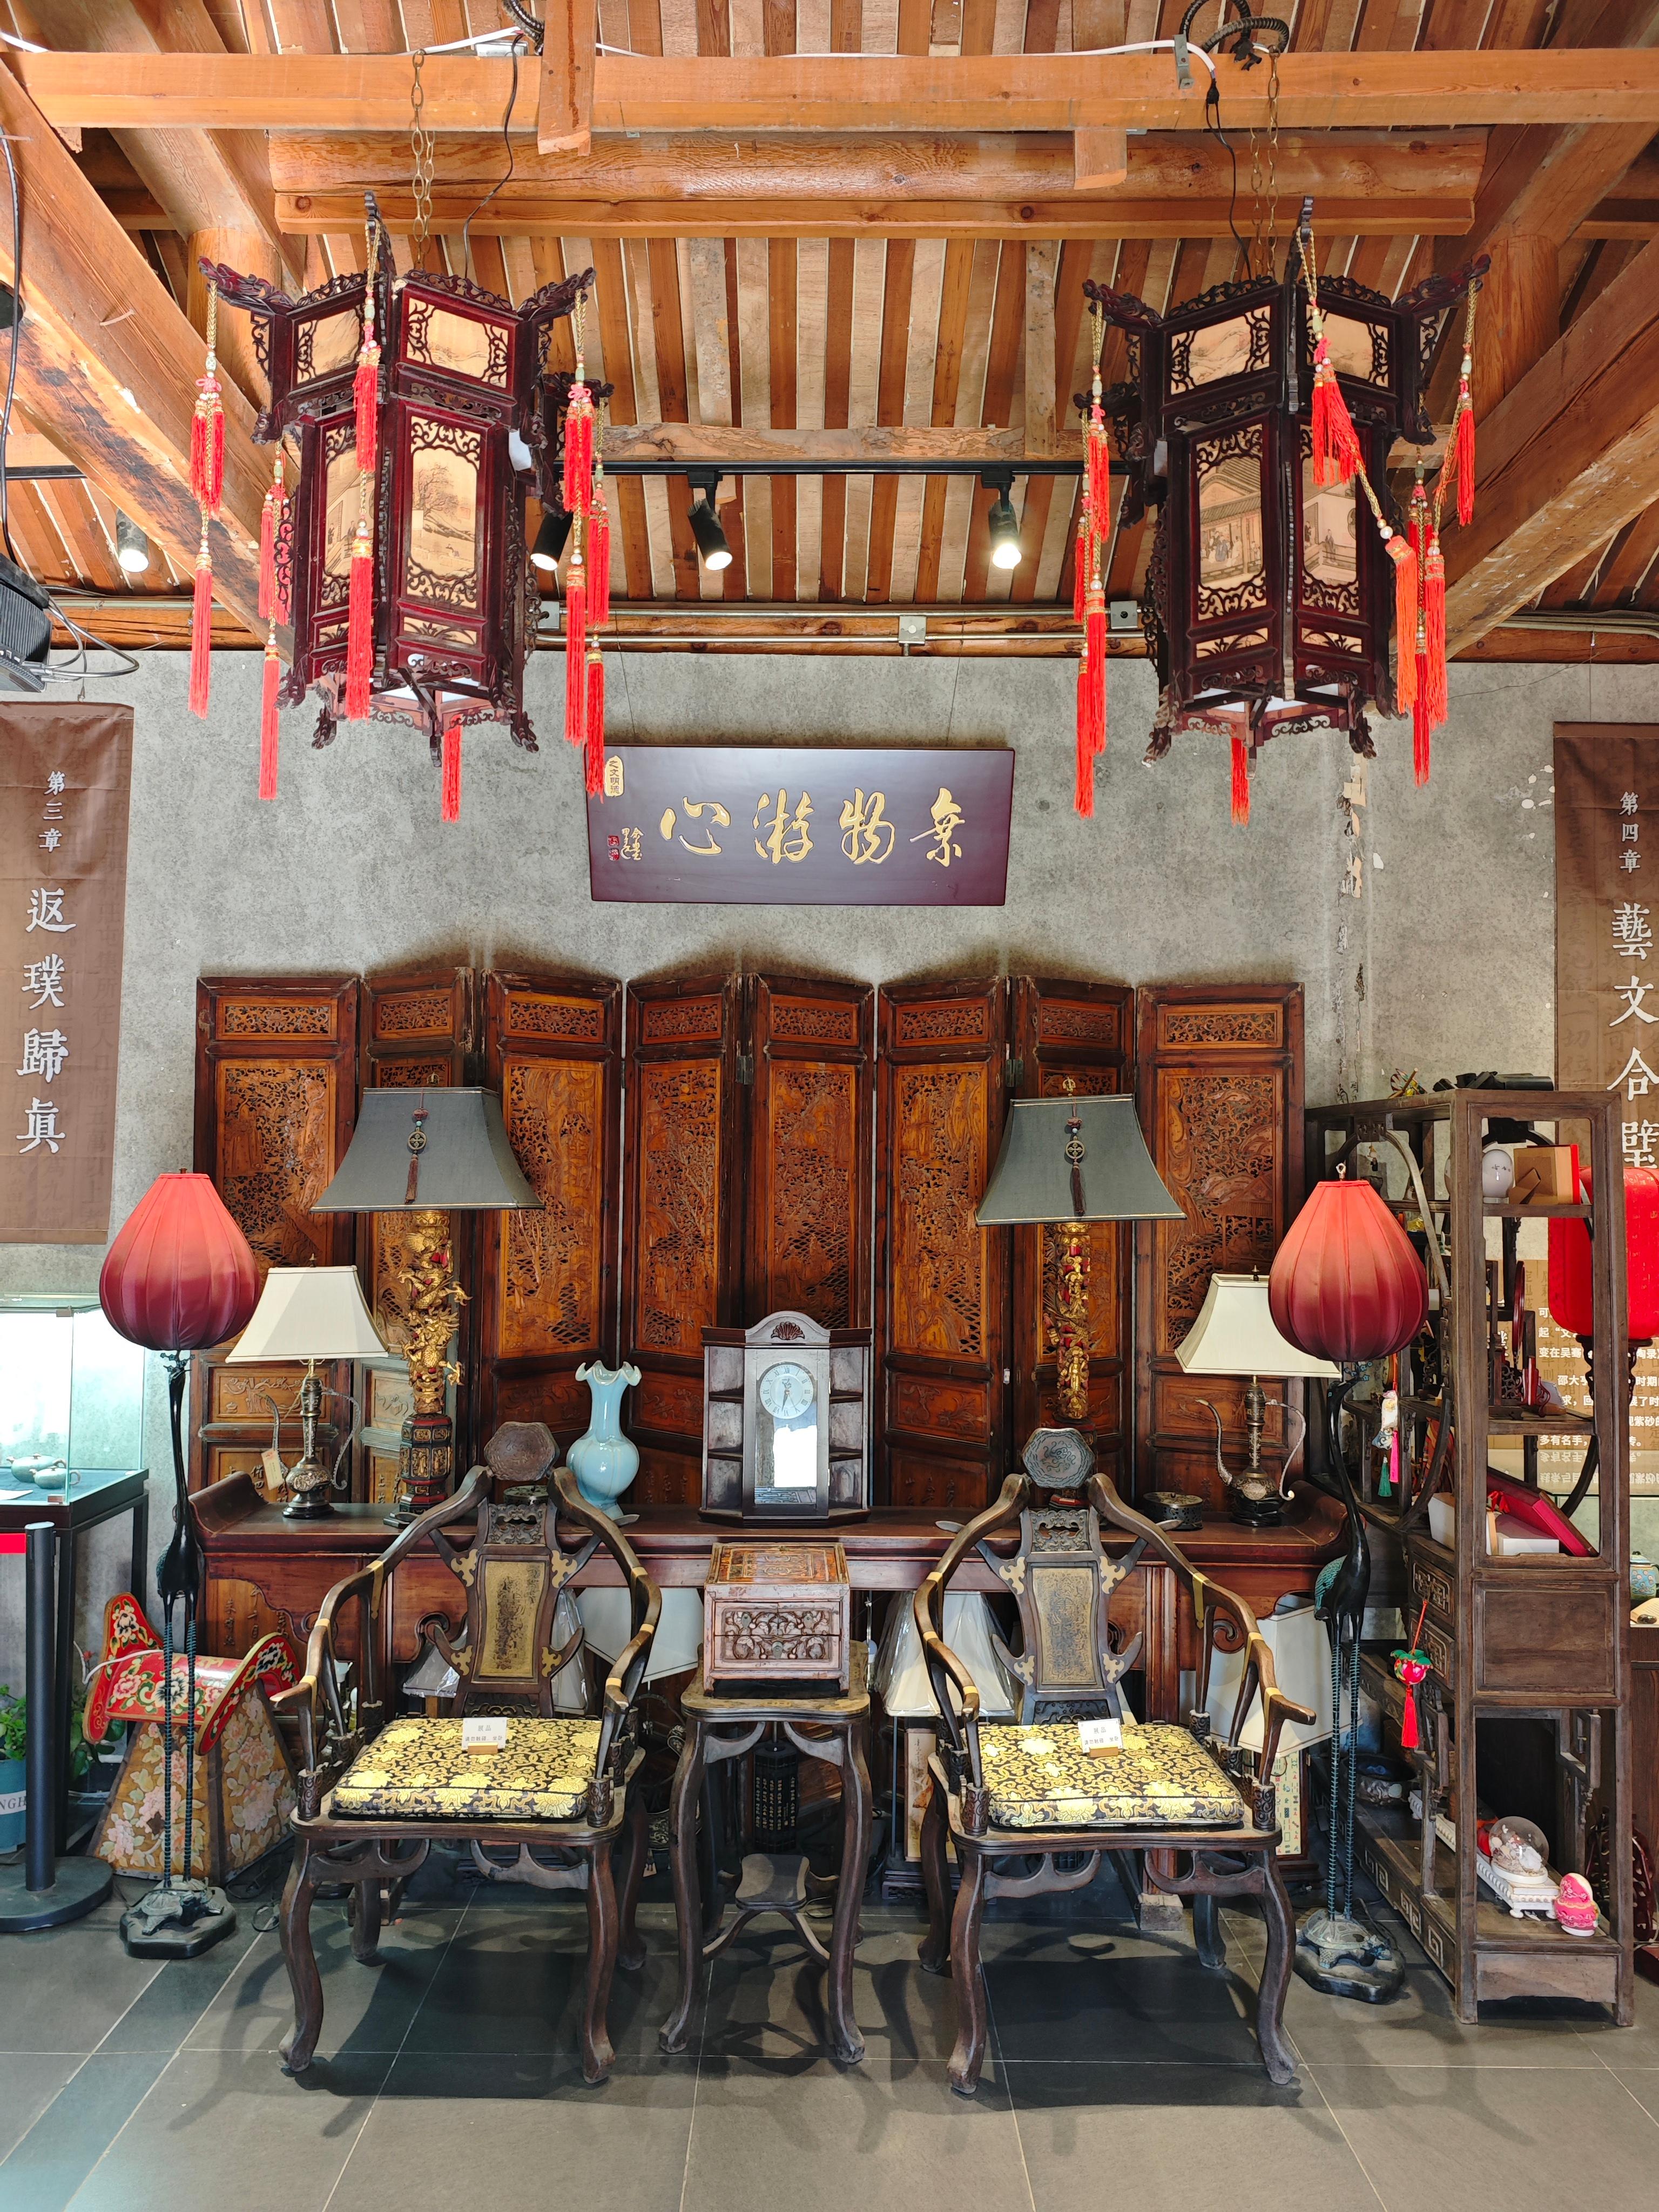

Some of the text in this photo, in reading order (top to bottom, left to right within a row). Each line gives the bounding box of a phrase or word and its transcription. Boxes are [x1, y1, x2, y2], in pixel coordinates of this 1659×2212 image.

[38, 771, 66, 852] 第三章
[1618, 791, 1641, 873] 第四章
[1636, 1375, 1659, 1387] 时期
